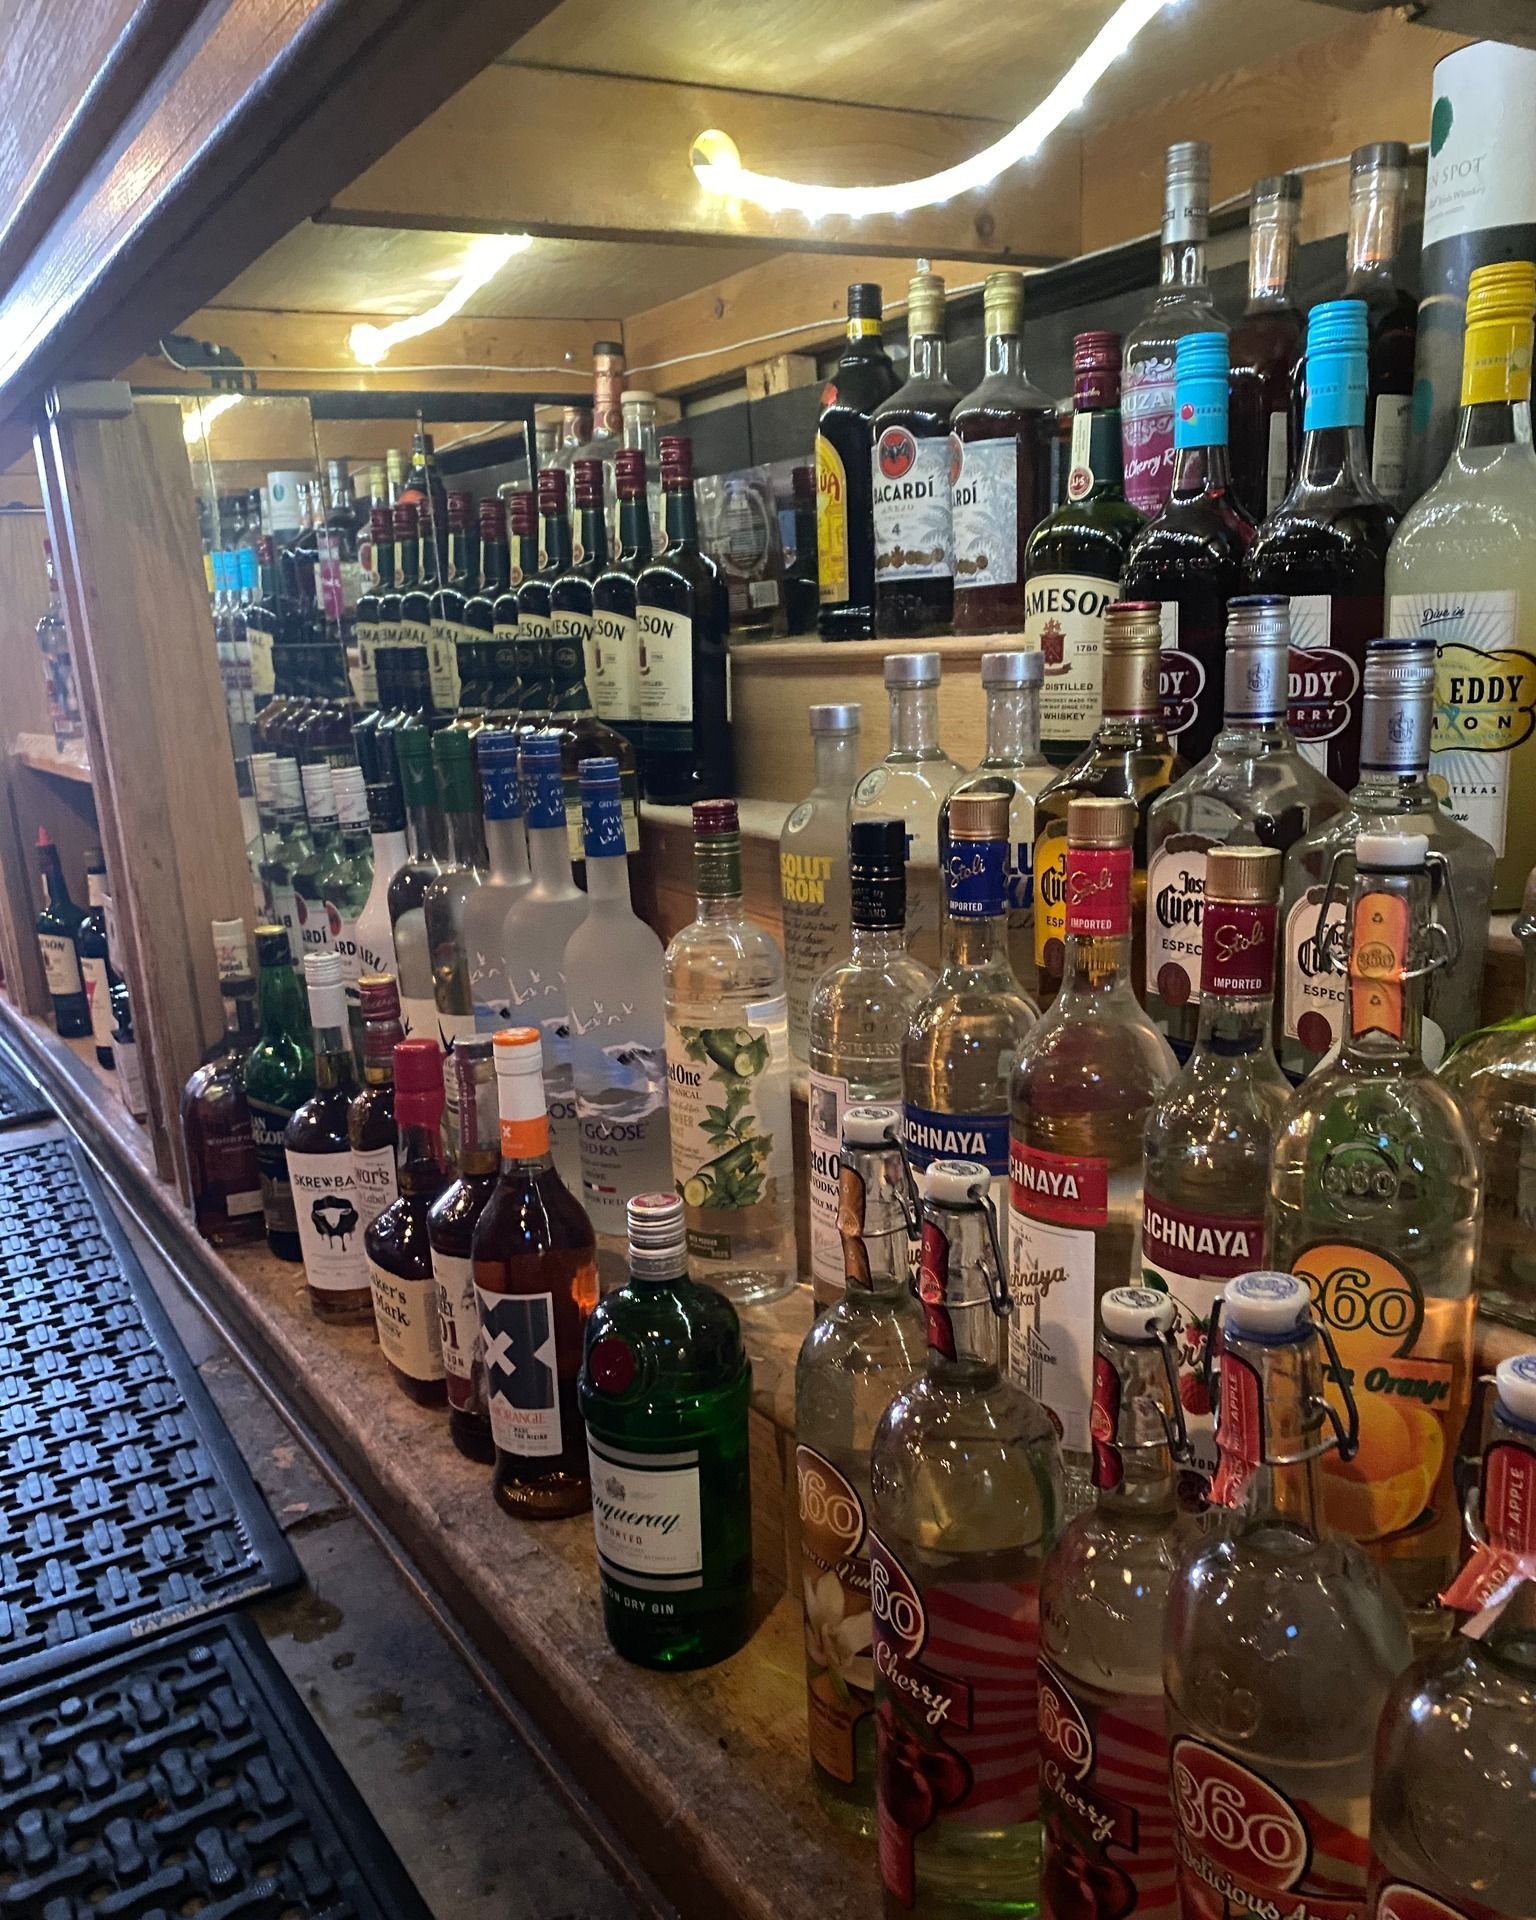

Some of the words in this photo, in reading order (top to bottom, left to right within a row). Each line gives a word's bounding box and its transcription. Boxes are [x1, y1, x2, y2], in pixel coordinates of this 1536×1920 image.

[1442, 157, 1481, 184] SPOT
[818, 467, 841, 501] ÚA
[874, 475, 935, 505] BACARDÍ
[1423, 609, 1450, 622] Dive
[1452, 608, 1466, 619] in
[1045, 682, 1094, 691] DISTILLED
[1449, 674, 1524, 705] EDDY
[1043, 712, 1086, 721] WHISKEY
[1453, 785, 1497, 795] TEXAS
[950, 900, 983, 912] IMPORTED
[1070, 917, 1112, 930] IMPORTED
[1214, 920, 1265, 963] Stoli
[1213, 976, 1263, 990] IMPORTED
[676, 1064, 702, 1087] One
[585, 1122, 647, 1142] GOOSE
[1227, 1373, 1238, 1424] APPLE
[1364, 1367, 1449, 1405] Orange
[1509, 1466, 1526, 1525] APPLE
[624, 1596, 646, 1612] DRY
[651, 1603, 675, 1616] GIN
[875, 1640, 952, 1725] Cherry
[1043, 1759, 1116, 1842] Cherry
[1174, 1762, 1300, 1869] 360
